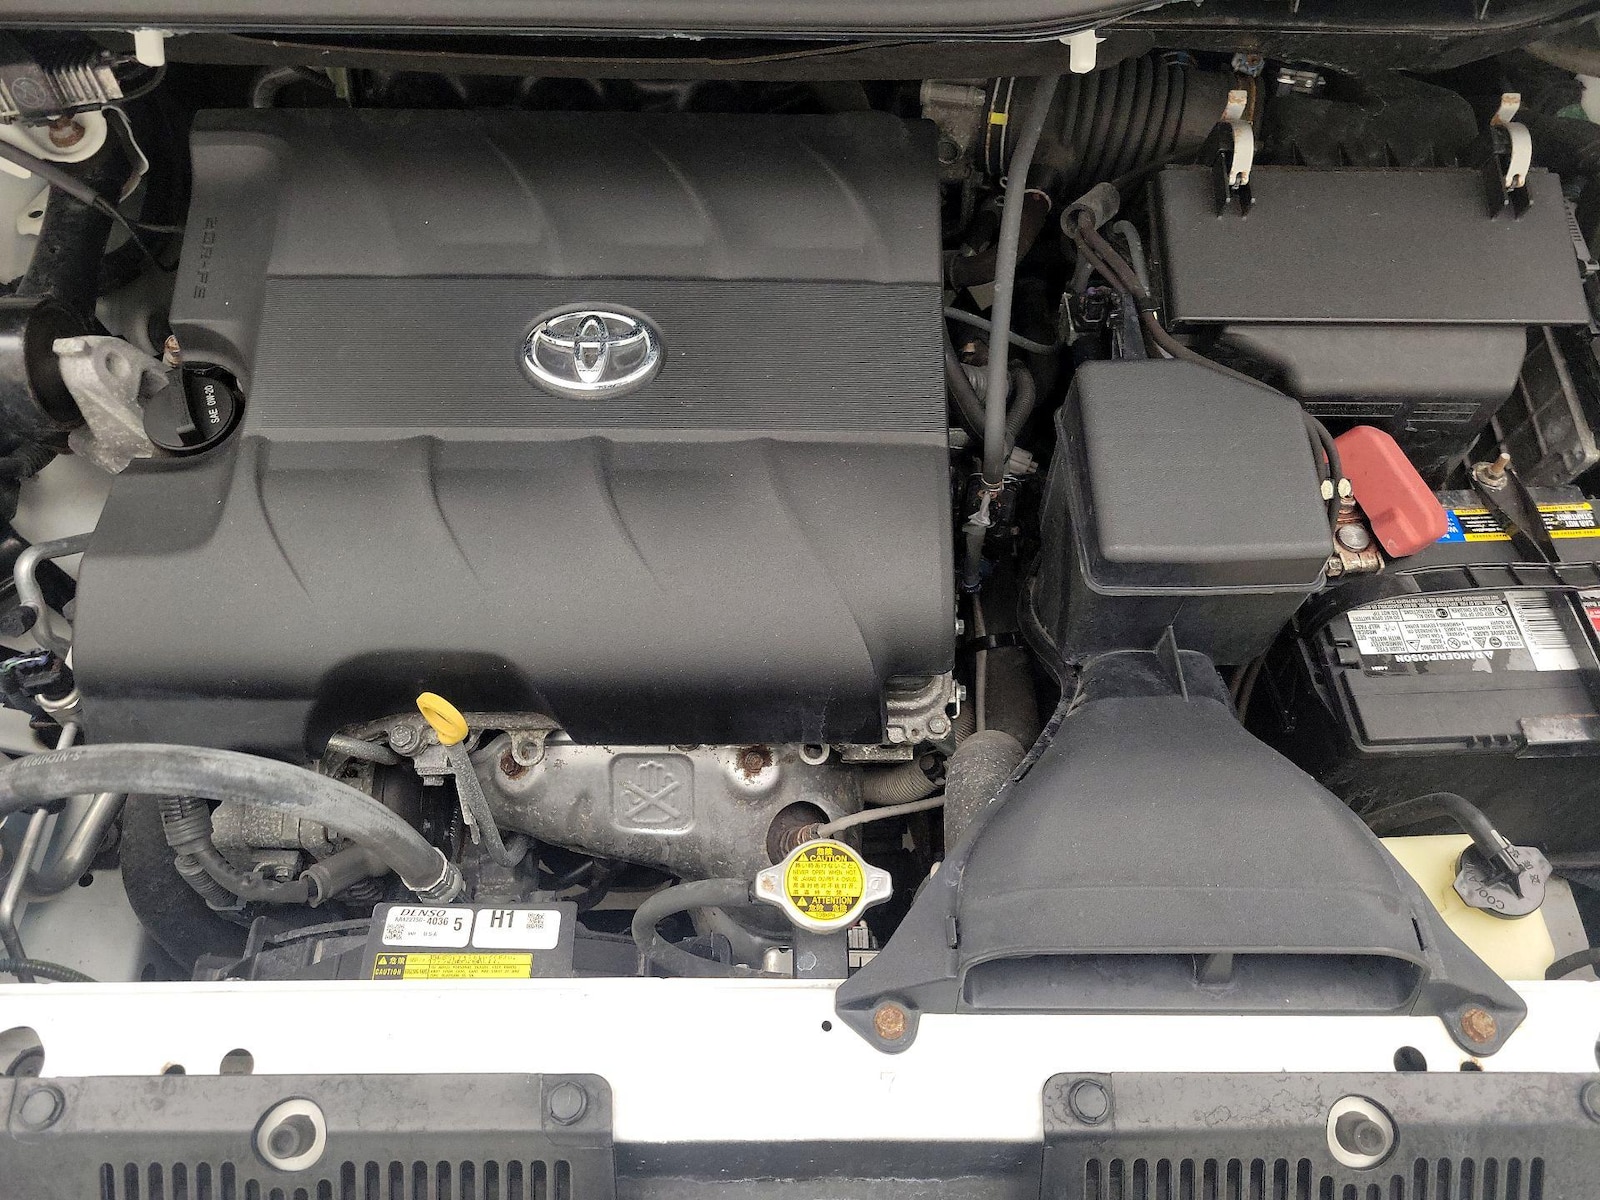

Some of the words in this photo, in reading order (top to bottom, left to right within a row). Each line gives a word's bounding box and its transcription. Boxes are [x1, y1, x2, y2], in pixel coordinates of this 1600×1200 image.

[204, 385, 216, 406] 0W-20
[208, 408, 220, 424] SAE
[1395, 651, 1483, 662] DANGER/POISON
[453, 917, 463, 932] 5
[490, 910, 515, 929] H1
[375, 968, 402, 976] CAUTION
